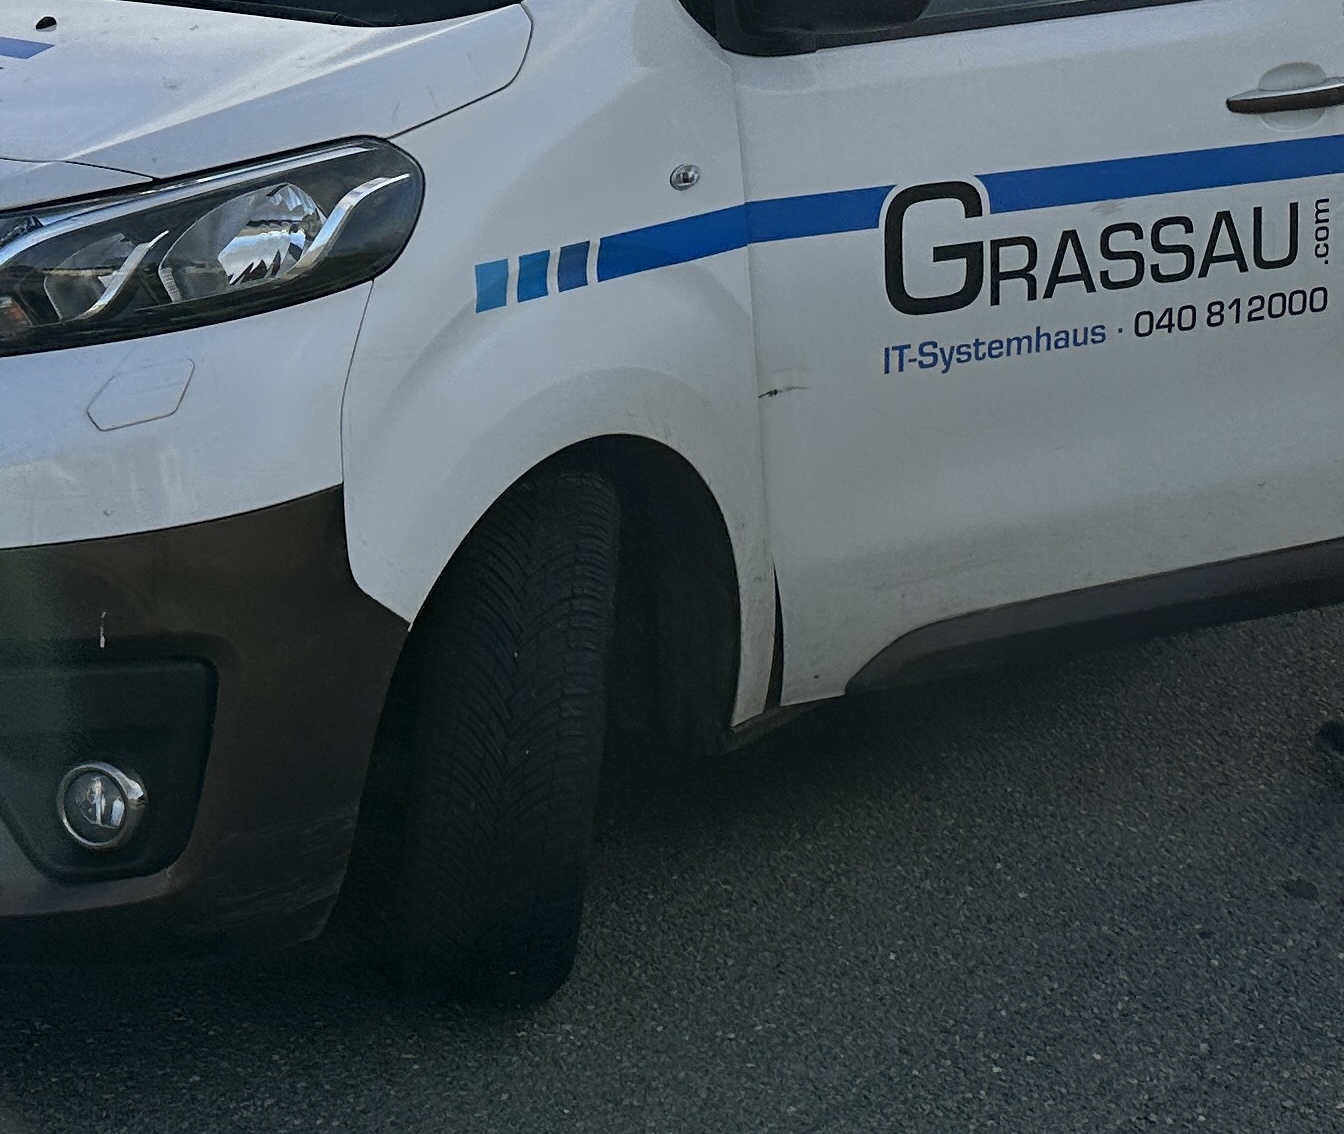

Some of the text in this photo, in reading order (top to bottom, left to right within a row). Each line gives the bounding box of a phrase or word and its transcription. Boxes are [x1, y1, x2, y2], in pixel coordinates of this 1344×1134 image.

[883, 179, 1331, 317] GRASSAU .com
[882, 285, 1331, 376] IT-Systemhaus 040 812000
